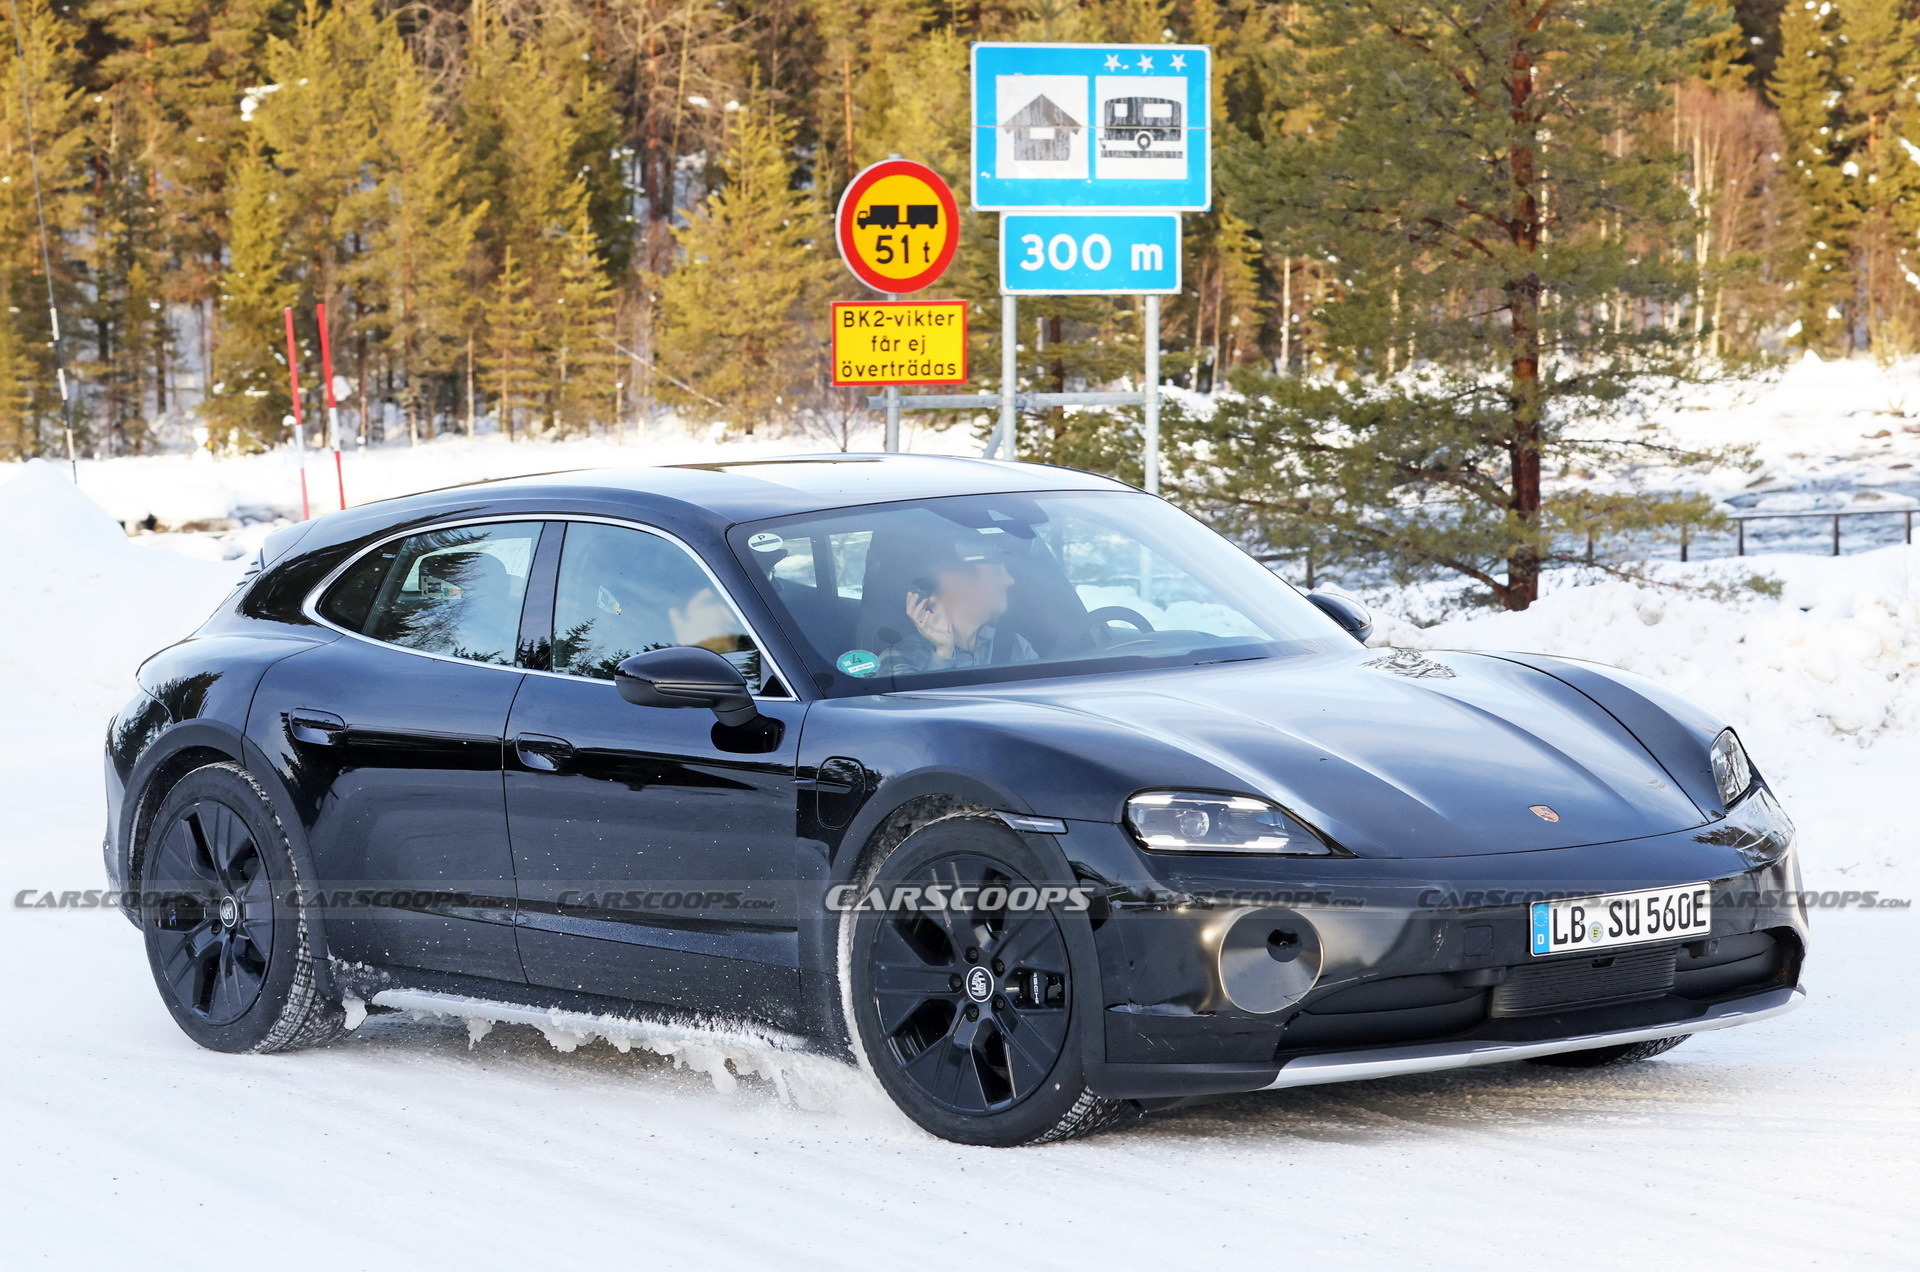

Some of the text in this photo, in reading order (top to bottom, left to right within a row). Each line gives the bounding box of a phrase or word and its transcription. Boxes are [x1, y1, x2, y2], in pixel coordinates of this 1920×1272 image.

[874, 233, 931, 264] 51 t
[1019, 233, 1164, 271] 300 m
[843, 310, 955, 328] BK2-vikter
[871, 335, 926, 355] får ej
[841, 359, 957, 378] överträdas
[852, 653, 863, 664] 4
[1553, 889, 1707, 945] LB SU 560E
[1537, 934, 1545, 945] D
